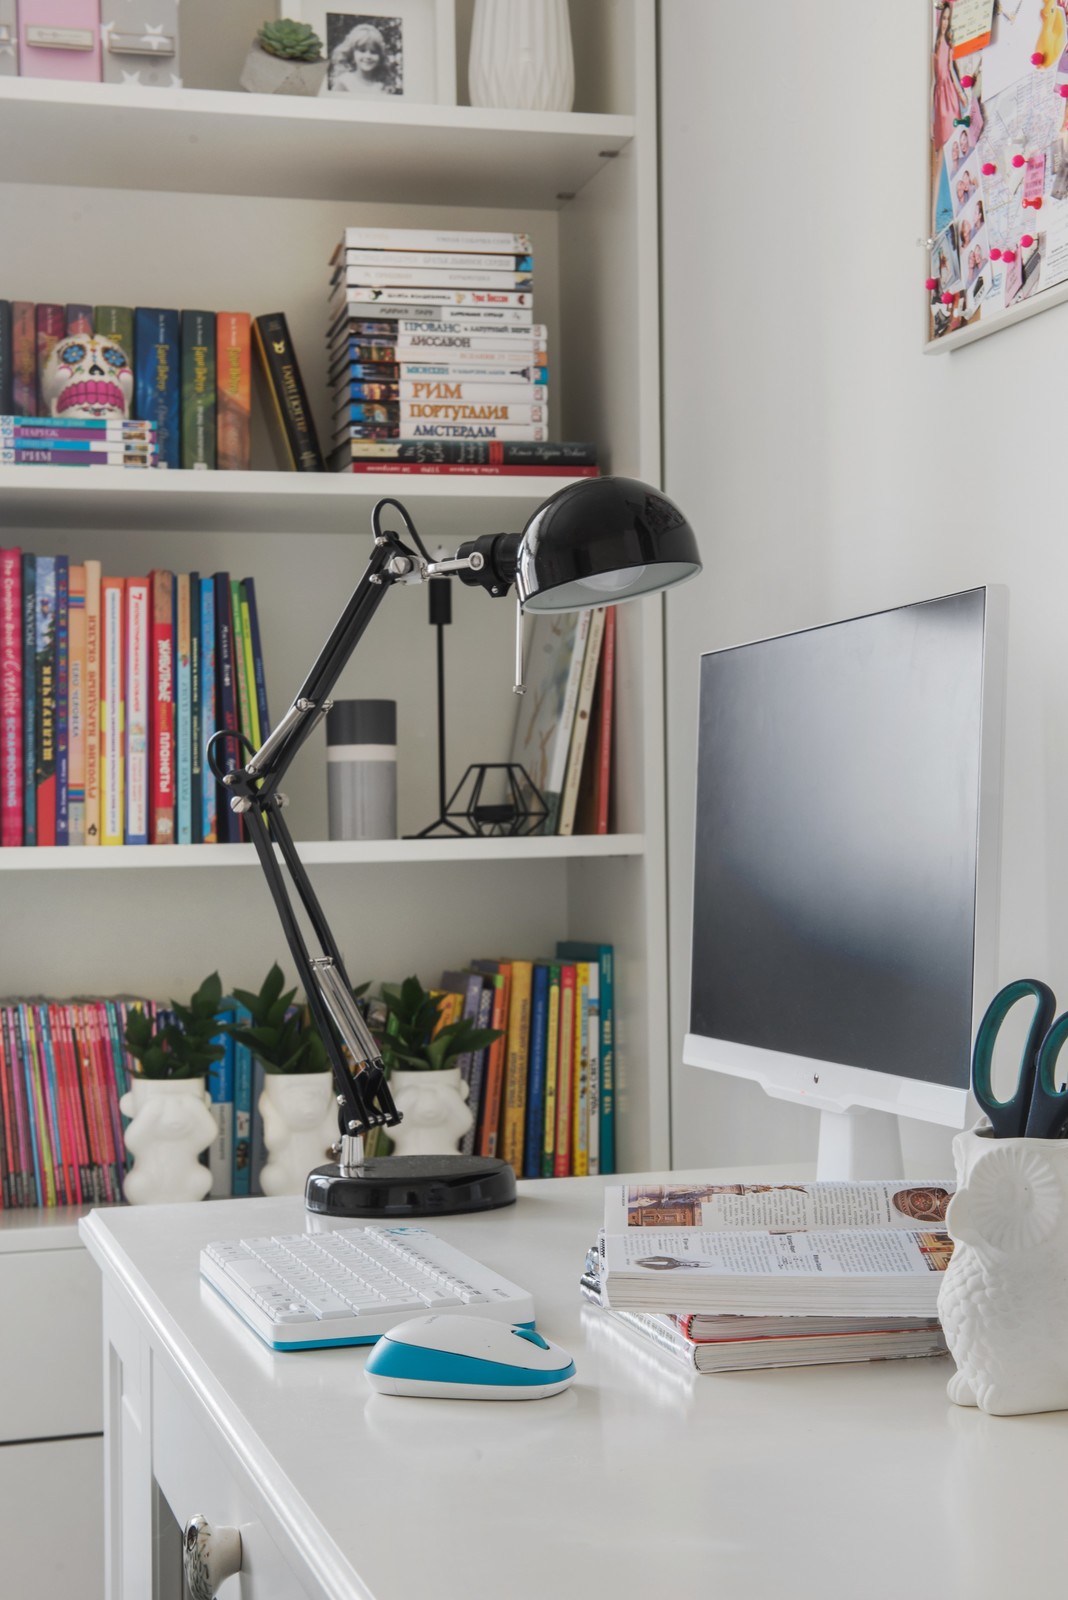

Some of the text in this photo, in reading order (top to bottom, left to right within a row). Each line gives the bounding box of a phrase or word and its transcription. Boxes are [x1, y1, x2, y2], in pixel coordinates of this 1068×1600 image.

[404, 322, 461, 333] ПРОВАНС
[410, 336, 471, 348] ЛИССАБОН
[412, 382, 462, 399] РИМ
[409, 404, 509, 421] ПОРТУГАЛИЯ
[20, 428, 59, 438] ПАРИЖ
[413, 425, 497, 438] АМСТЕРДАМ
[21, 451, 52, 462] РИМ
[132, 593, 143, 601] 7
[26, 595, 34, 647] РУСАЛОЧКА
[3, 560, 21, 806] The Complete Book of Creative SCRAPBOOKING
[42, 666, 52, 761] ЩЕЛКУНЧИК
[72, 689, 80, 737] ЧЕЛОВЕКА
[87, 615, 98, 799] РУССКИЕ НАРОДНЫЕ СКАЗКИ
